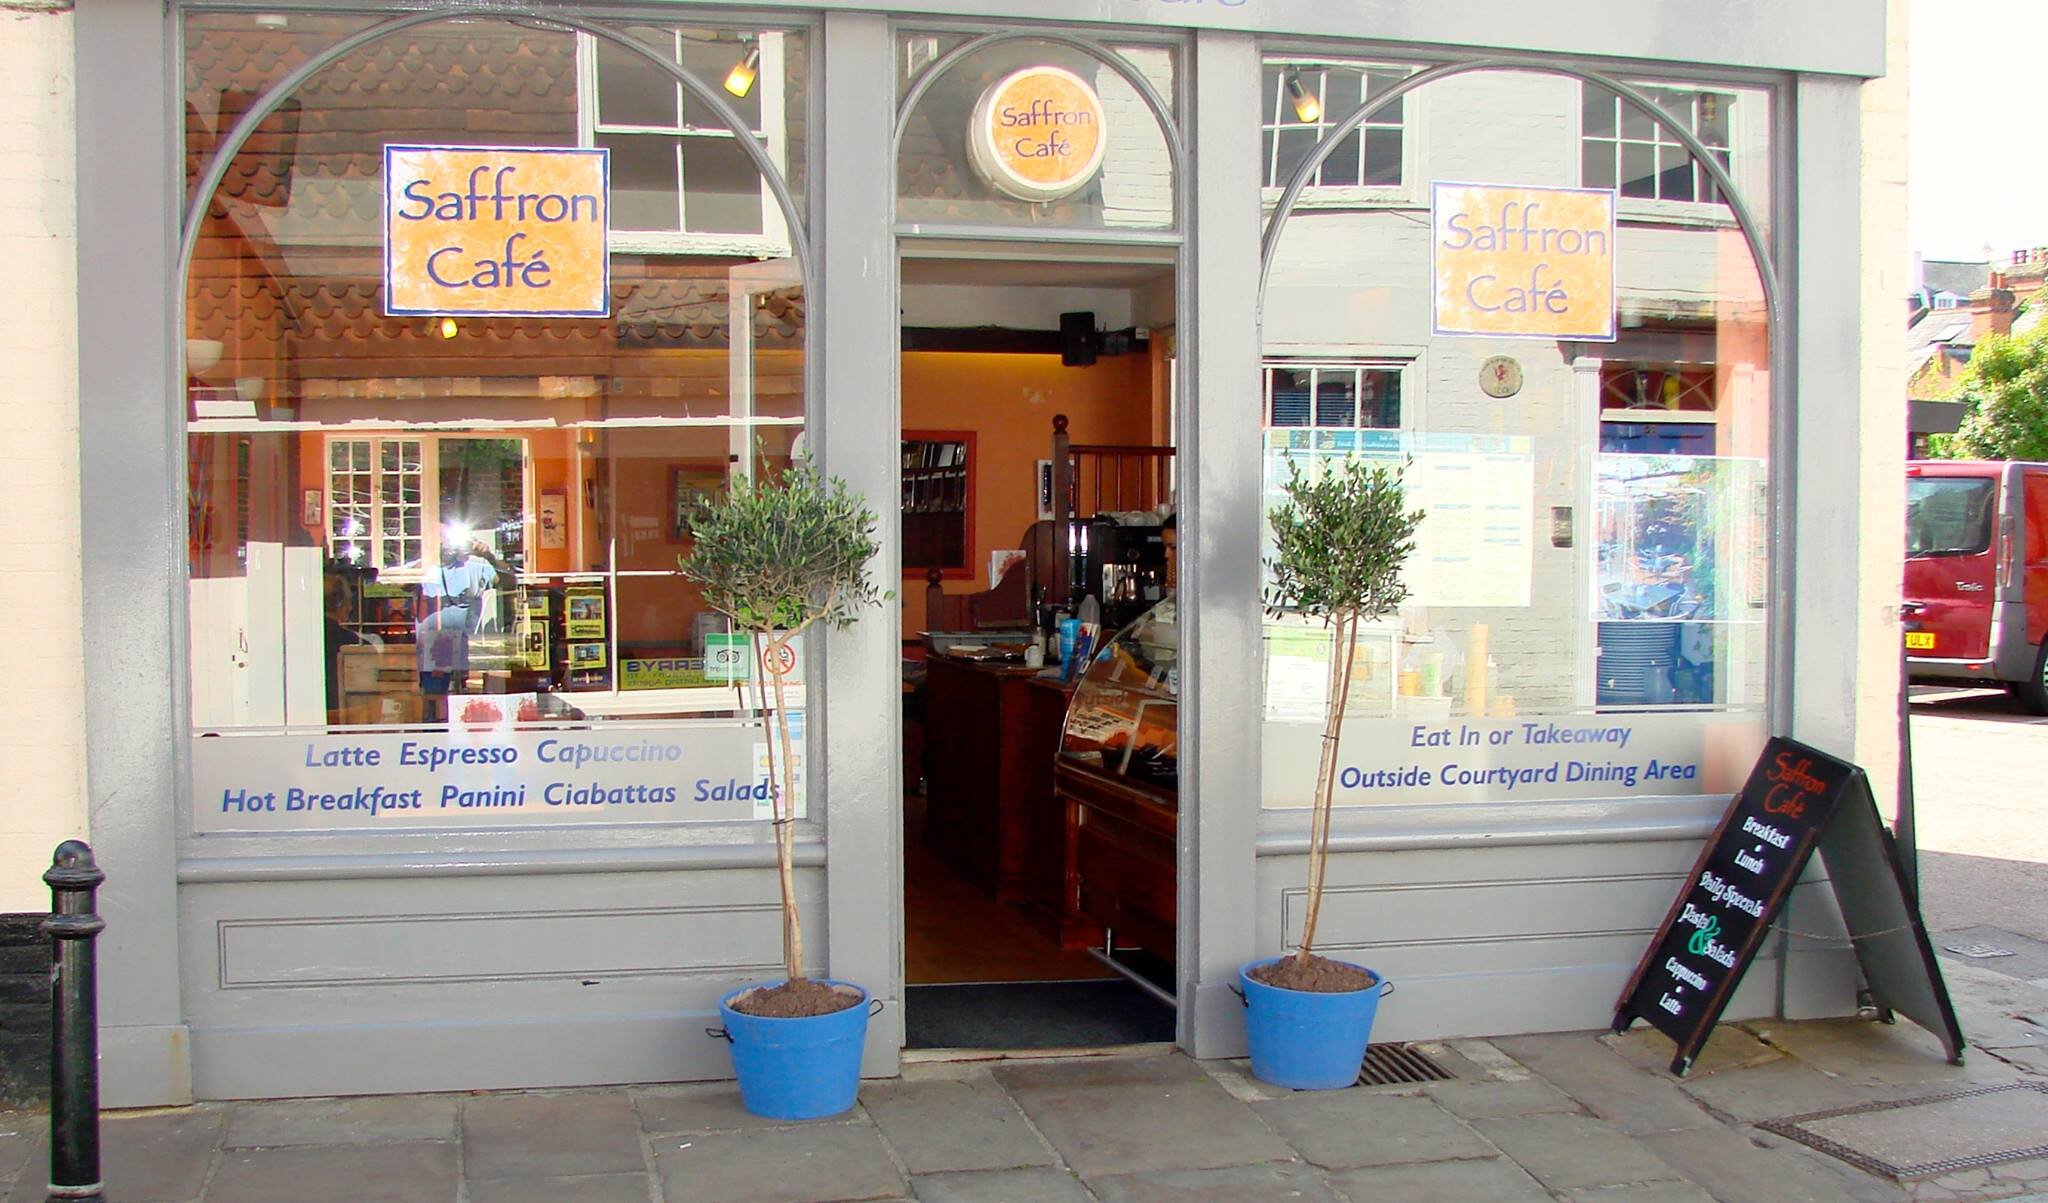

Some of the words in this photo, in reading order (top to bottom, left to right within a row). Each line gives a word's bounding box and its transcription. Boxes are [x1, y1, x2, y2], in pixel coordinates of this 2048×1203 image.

[1000, 100, 1091, 127] Saffron
[1015, 131, 1072, 158] Café
[398, 166, 598, 222] Saffron
[1442, 202, 1606, 255] Saffron
[427, 233, 552, 288] Café
[1467, 264, 1568, 314] Café
[1411, 726, 1451, 747] Eat
[1459, 725, 1480, 746] In
[1489, 730, 1513, 745] or
[1522, 723, 1632, 748] Takeaway
[305, 743, 381, 767] Latte
[400, 741, 518, 772] Espresso
[537, 739, 682, 769] Capuccino
[1340, 766, 1431, 788] Outside
[1440, 763, 1559, 790] Courtyard
[1566, 760, 1637, 786] Dining
[1644, 759, 1695, 780] Area
[1767, 751, 1826, 794] Saffron
[222, 788, 276, 812] Hot
[286, 786, 422, 816] Breakfast
[440, 784, 525, 808] Panini
[544, 782, 676, 806] Ciabattas
[694, 778, 780, 801] Salads
[1742, 816, 1790, 849] Breakfast
[1733, 849, 1764, 874] Lunch
[1699, 871, 1727, 901] Daily
[1723, 885, 1765, 917] Specials
[1677, 903, 1711, 930] Pasta
[1688, 915, 1721, 956] &
[1703, 939, 1736, 968] Salads
[1659, 993, 1683, 1015] Latte
